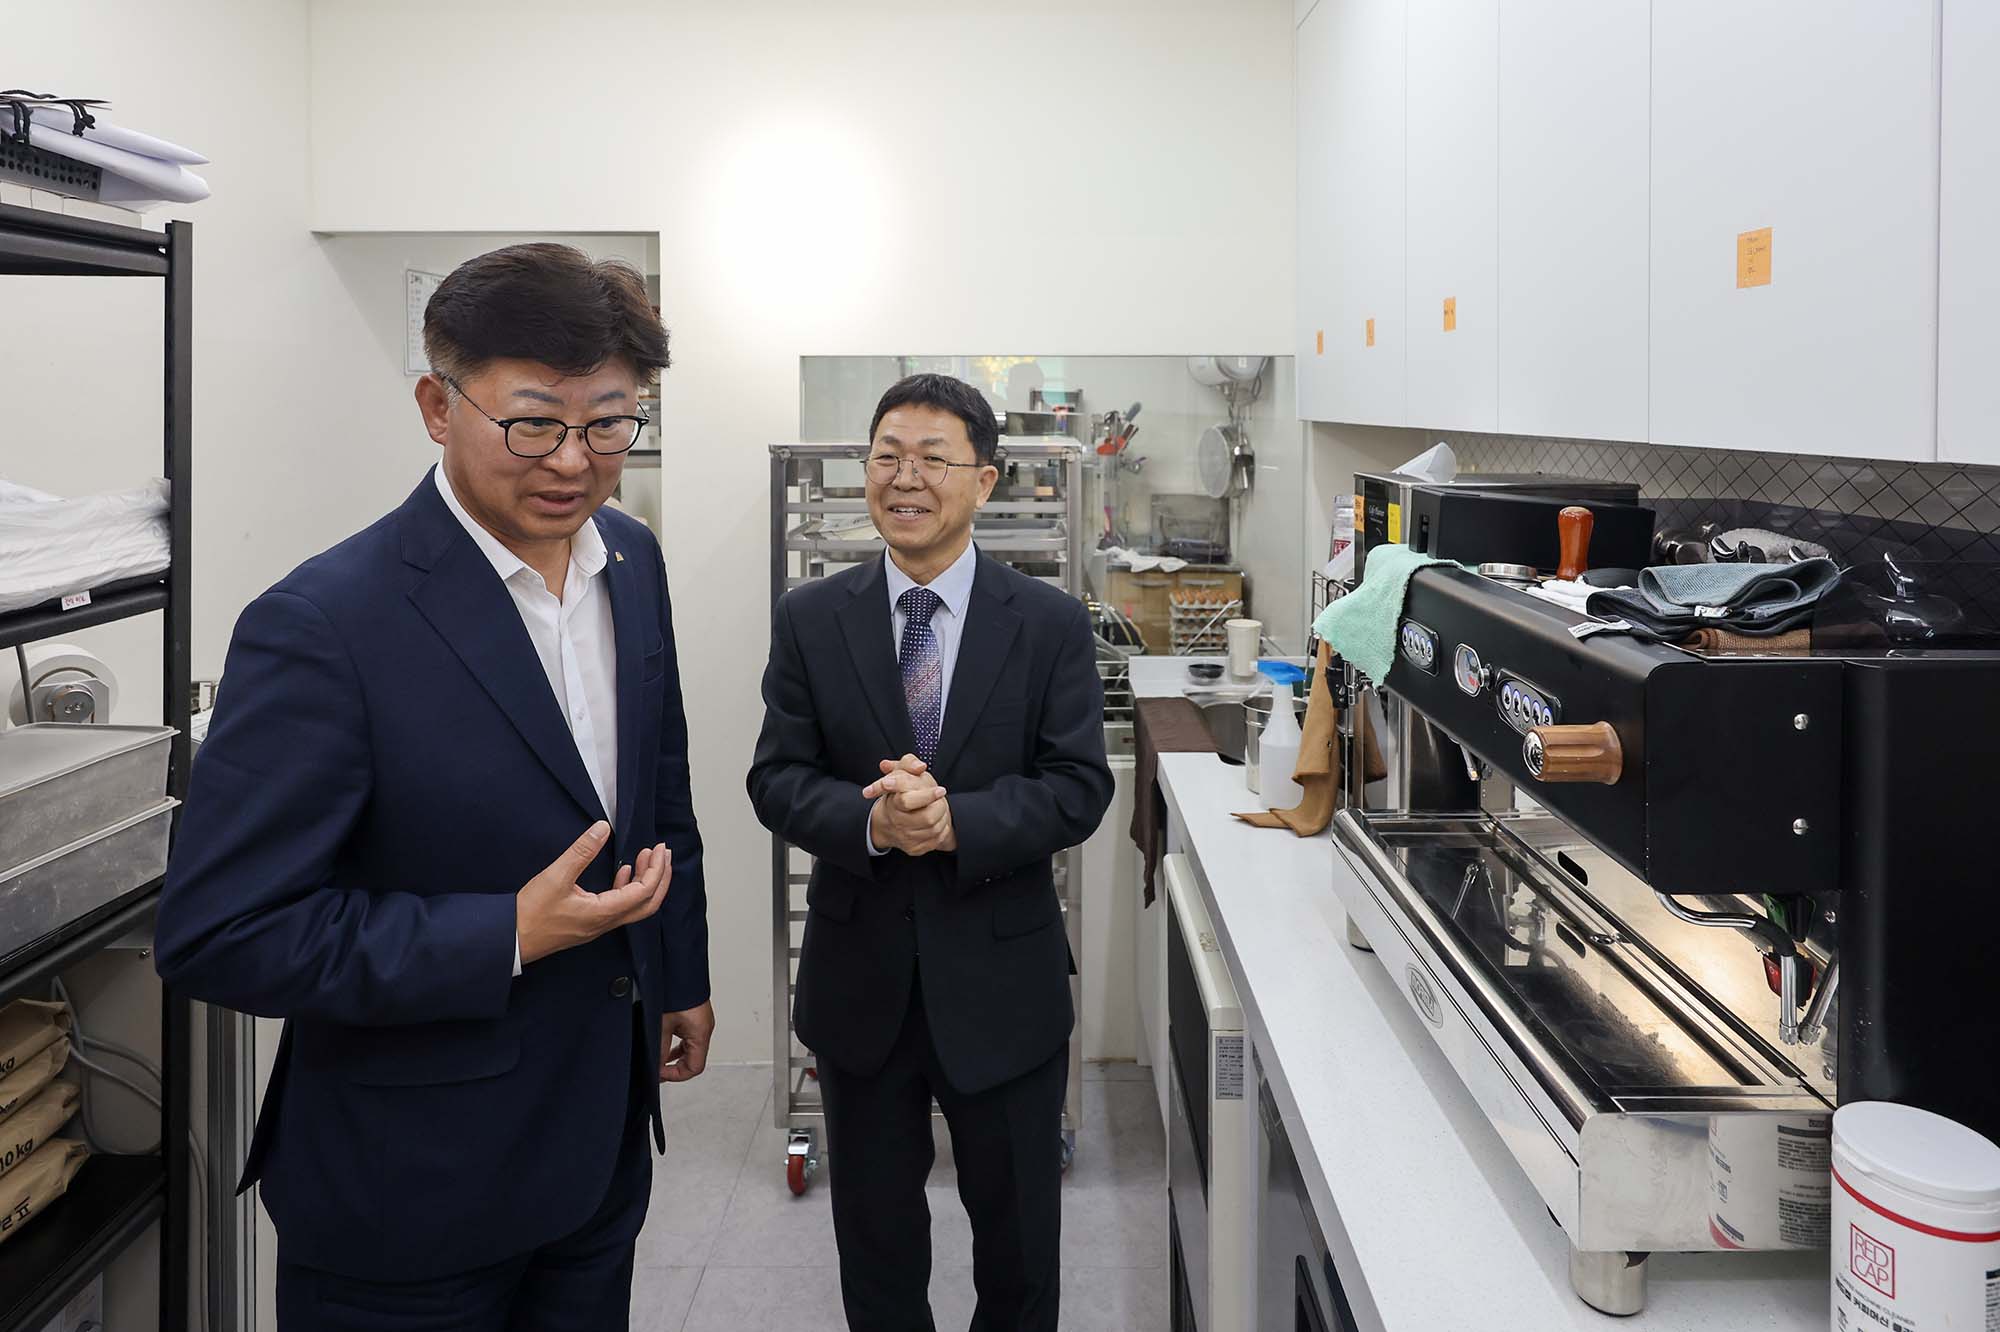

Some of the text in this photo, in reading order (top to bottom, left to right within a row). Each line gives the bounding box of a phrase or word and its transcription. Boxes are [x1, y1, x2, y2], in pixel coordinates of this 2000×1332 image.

[16, 1138, 33, 1158] kg
[1855, 1232, 1889, 1268] RED
[1854, 1254, 1889, 1287] CAP
[1853, 1296, 1889, 1328] 커피머신
